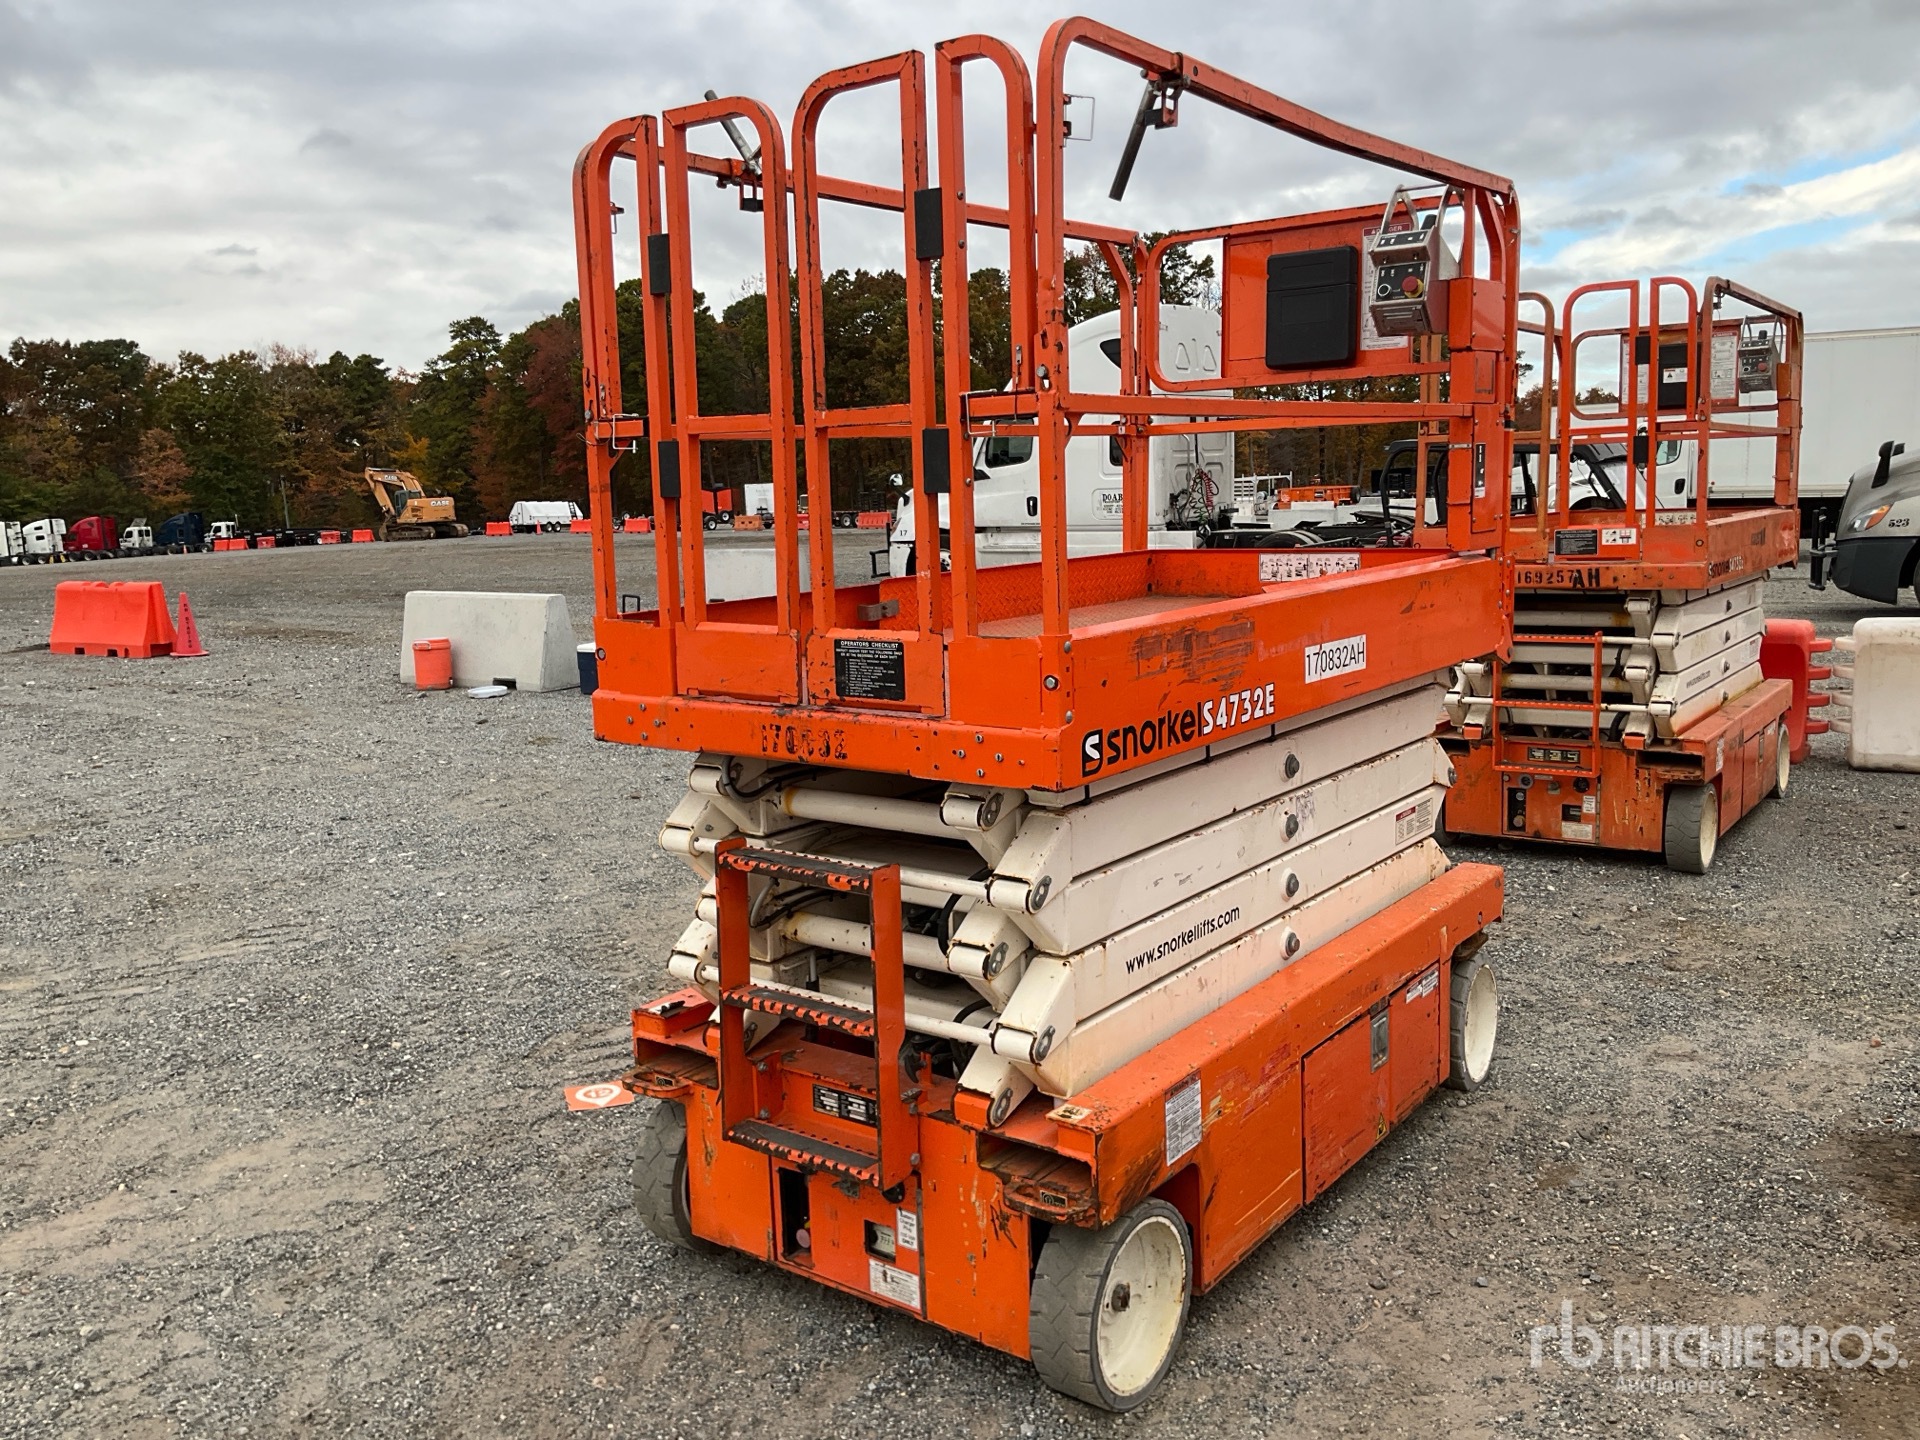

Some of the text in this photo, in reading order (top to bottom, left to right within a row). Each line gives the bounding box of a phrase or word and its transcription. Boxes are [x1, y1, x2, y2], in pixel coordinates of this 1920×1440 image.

[1888, 518, 1910, 528] 523
[1306, 641, 1365, 676] 170832AH
[1107, 702, 1202, 765] snorkel
[1202, 682, 1276, 737] S4732E
[1126, 906, 1240, 974] www.snorkellifts.com
